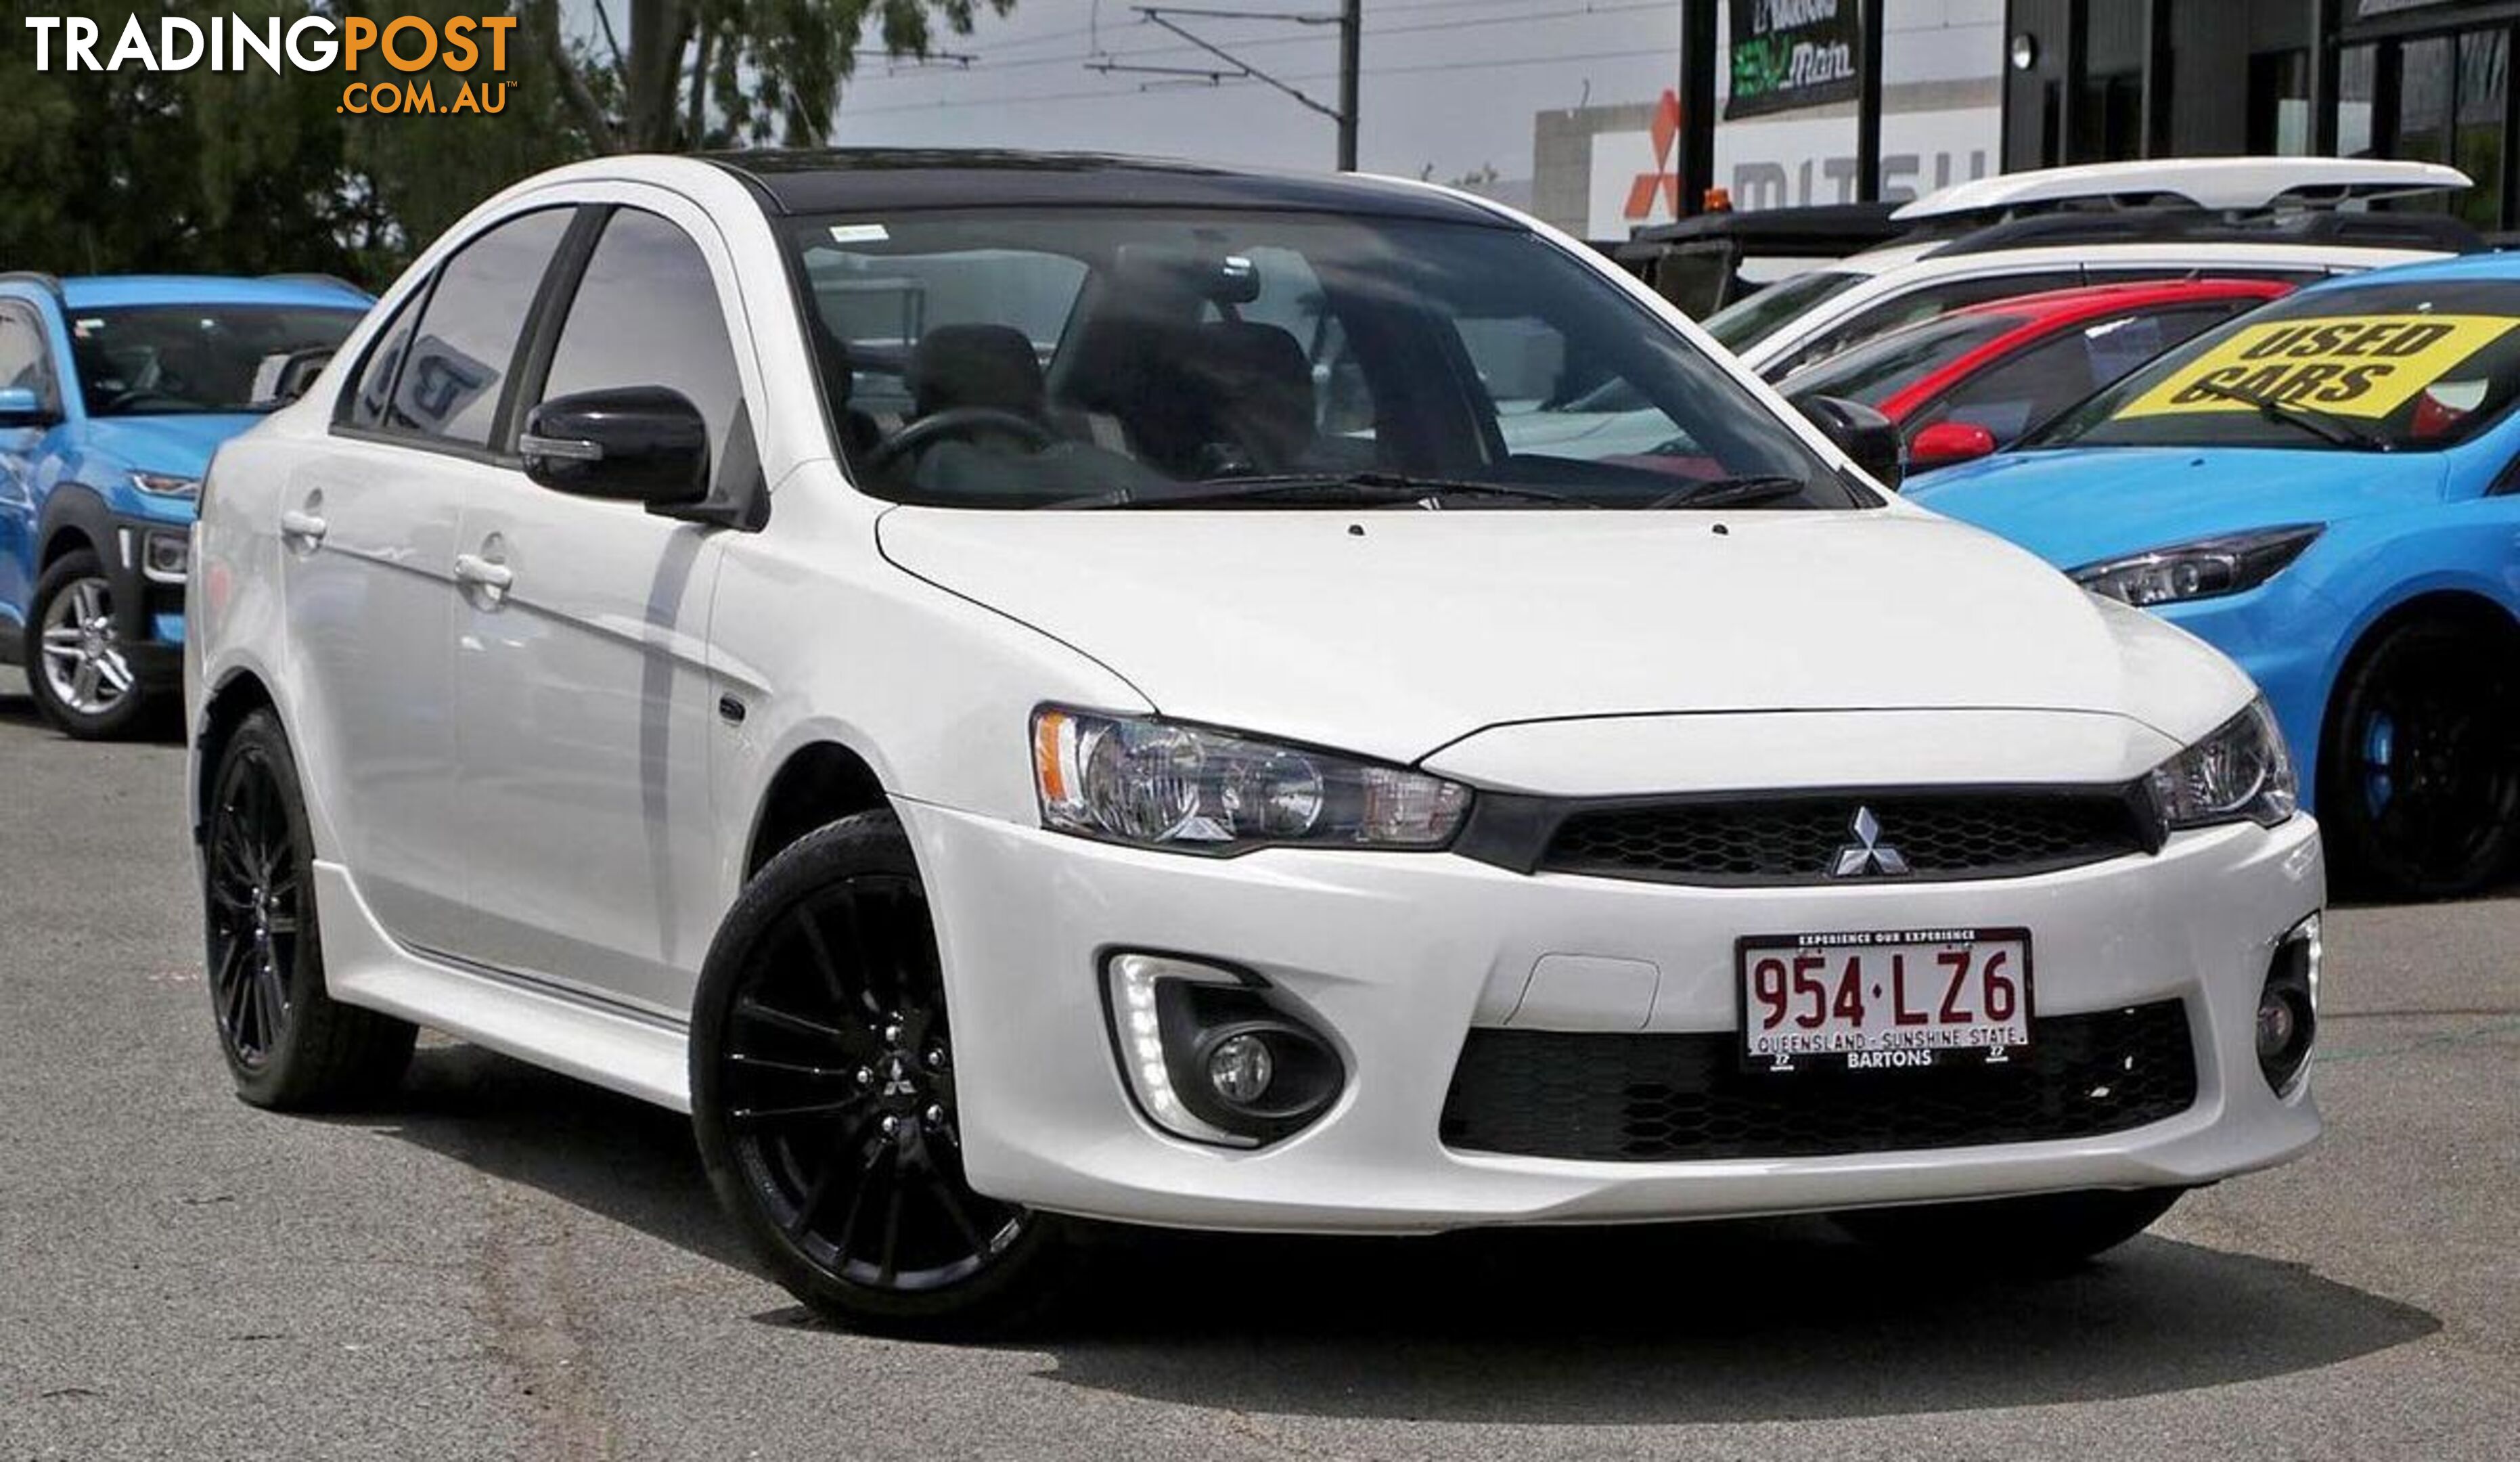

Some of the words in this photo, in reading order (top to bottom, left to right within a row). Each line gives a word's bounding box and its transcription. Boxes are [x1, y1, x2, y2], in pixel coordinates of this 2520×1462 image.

[2239, 324, 2456, 360] USED
[2169, 363, 2397, 404] CARS
[1798, 933, 1870, 946] EXPERIENCE
[1874, 932, 1901, 943] OUR
[1904, 930, 1976, 942] EXPERIENCE
[1758, 1033, 1866, 1054] QUEENSLAND
[1883, 1029, 1960, 1049] SUNSHINE
[1969, 1027, 2017, 1044] STATE
[1847, 1050, 1932, 1069] BARTONS
